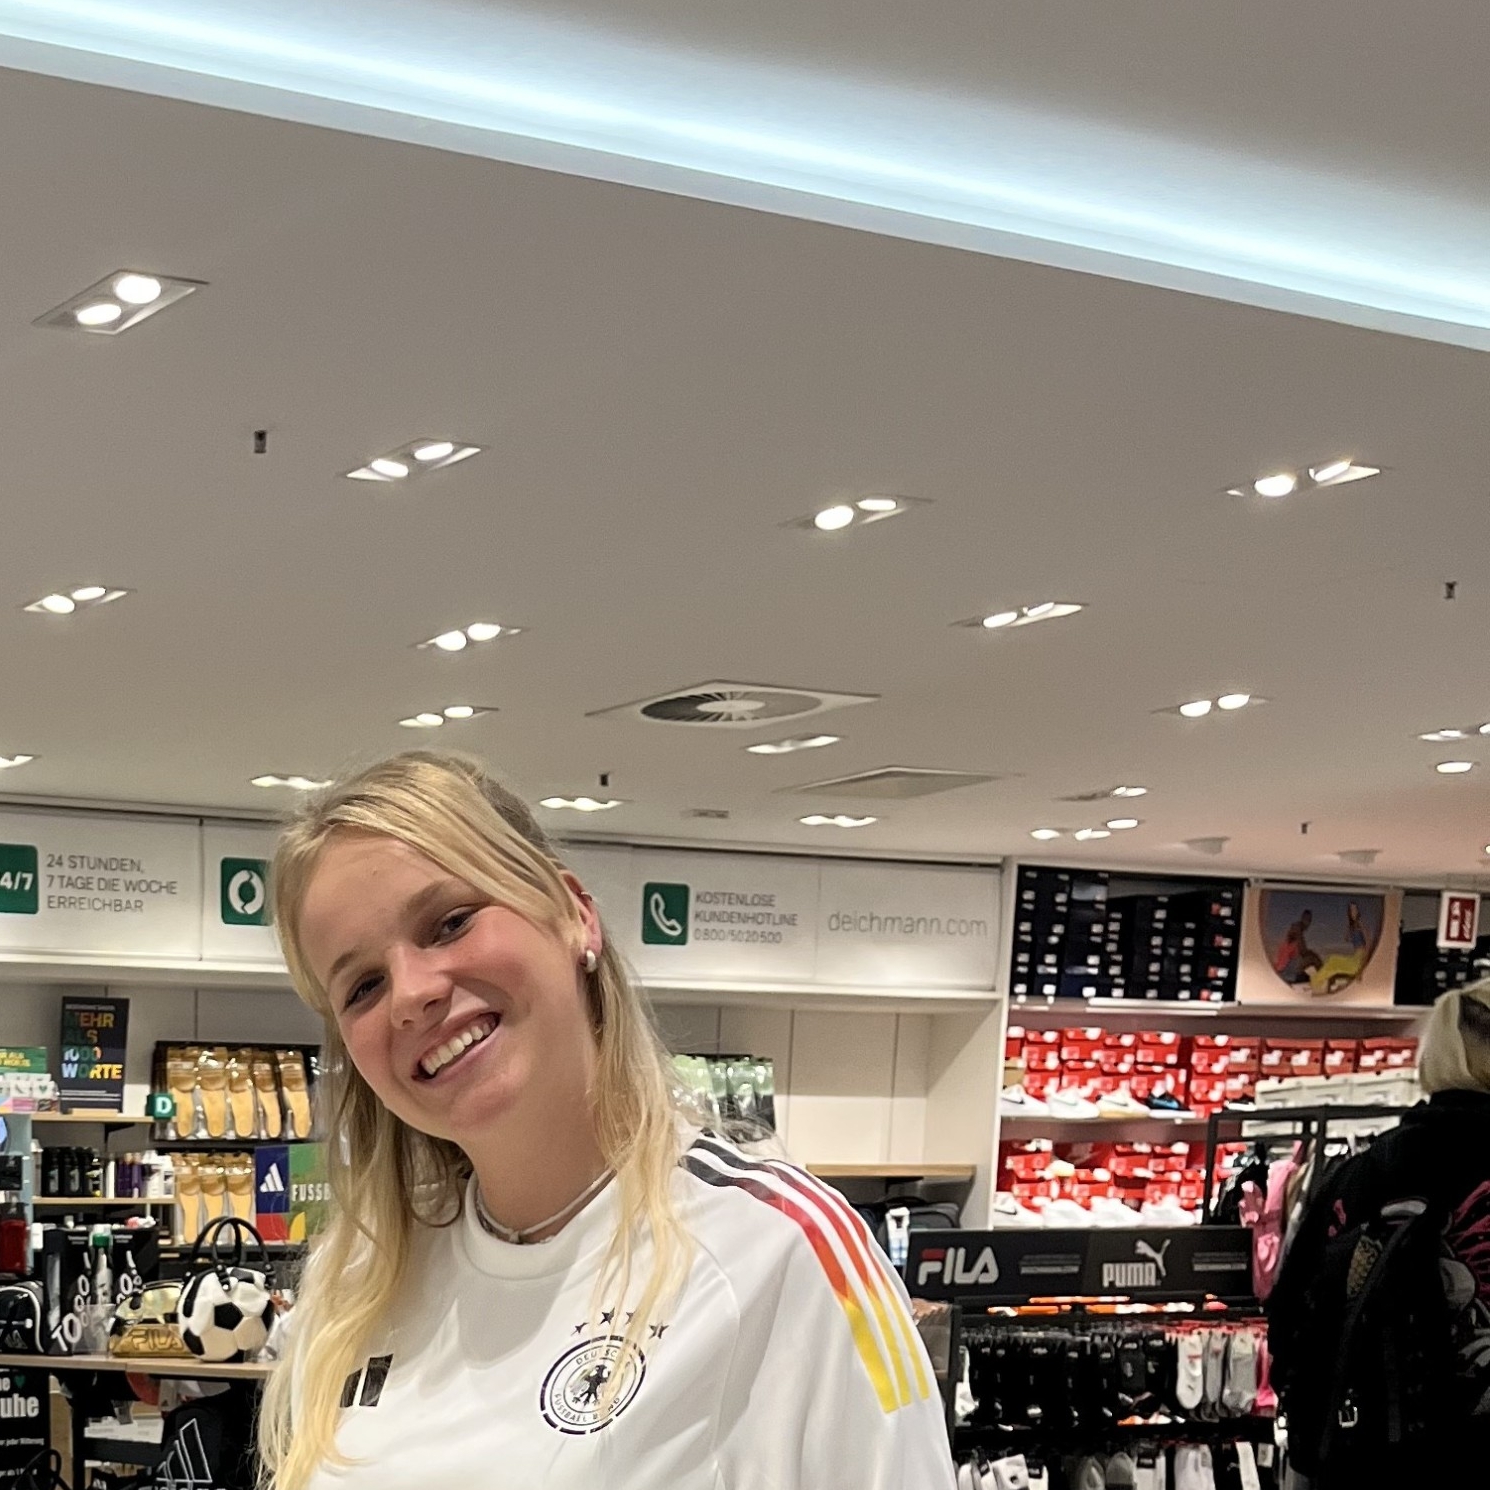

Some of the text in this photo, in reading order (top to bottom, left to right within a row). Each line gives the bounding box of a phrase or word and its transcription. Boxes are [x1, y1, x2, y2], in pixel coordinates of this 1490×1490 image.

[46, 854, 63, 868] 24
[46, 875, 178, 895] 7 TAGE DIE WOCHE
[47, 895, 144, 912] ERREICHBAR
[696, 891, 776, 907] KOSTENLOSE
[695, 911, 798, 926] KUNDENHOTLINE
[828, 911, 988, 937] deichmann.com
[61, 1063, 123, 1079] WORTE
[155, 1097, 172, 1113] D
[917, 1246, 999, 1286] FILA
[1102, 1262, 1158, 1288] PUMA
